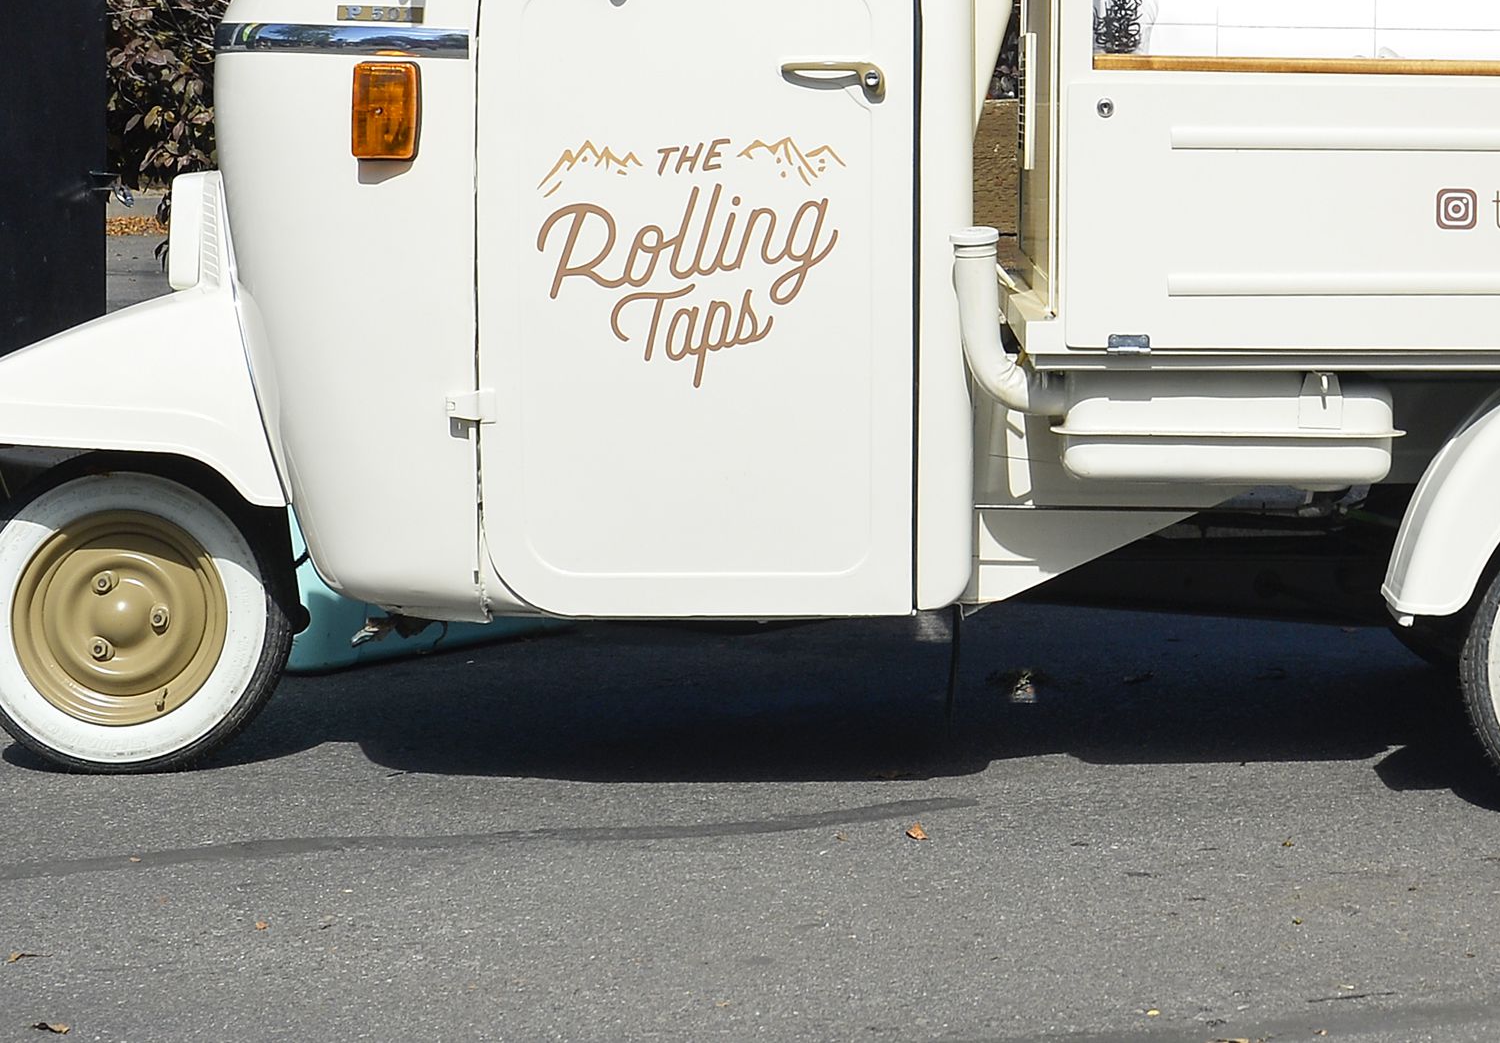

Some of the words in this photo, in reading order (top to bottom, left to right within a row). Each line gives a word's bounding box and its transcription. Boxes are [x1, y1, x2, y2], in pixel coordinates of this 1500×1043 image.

[346, 6, 362, 20] P
[657, 138, 731, 177] THE
[537, 183, 838, 305] Rolling
[610, 283, 774, 389] Taps
